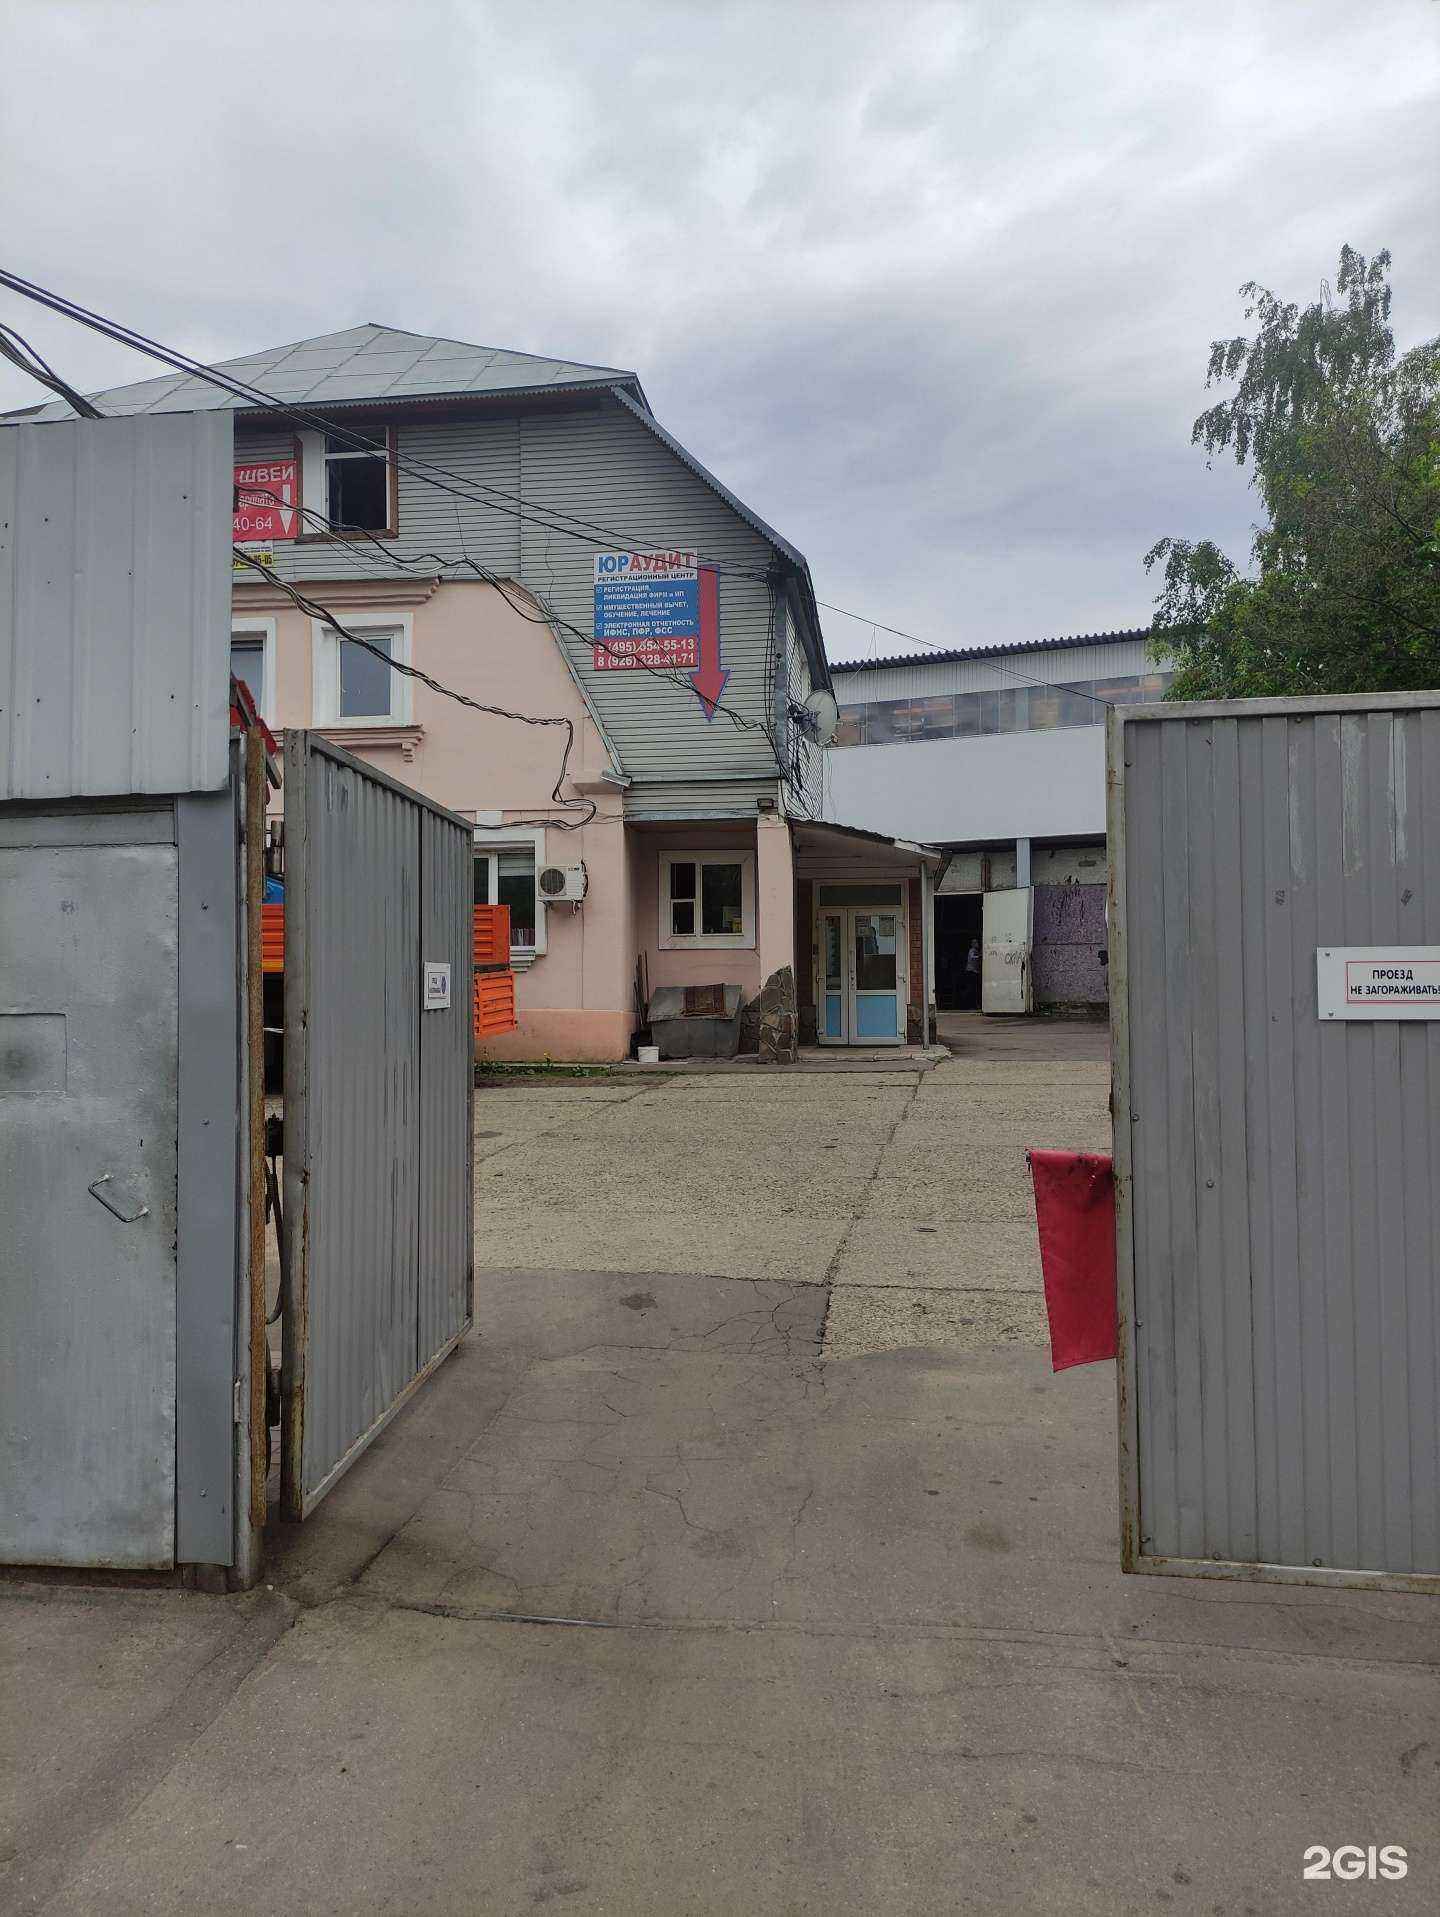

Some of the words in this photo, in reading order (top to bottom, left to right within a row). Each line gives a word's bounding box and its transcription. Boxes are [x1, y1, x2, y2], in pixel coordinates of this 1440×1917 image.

[598, 552, 695, 574] ЮРАУДИТ
[671, 572, 695, 580] ЦЕНТР
[655, 626, 673, 634] ФСС
[608, 641, 636, 652] (495)
[598, 656, 604, 666] 8
[608, 655, 636, 667] (926)
[1372, 969, 1413, 981] ПРОЕЗД
[1350, 985, 1365, 995] НЕ
